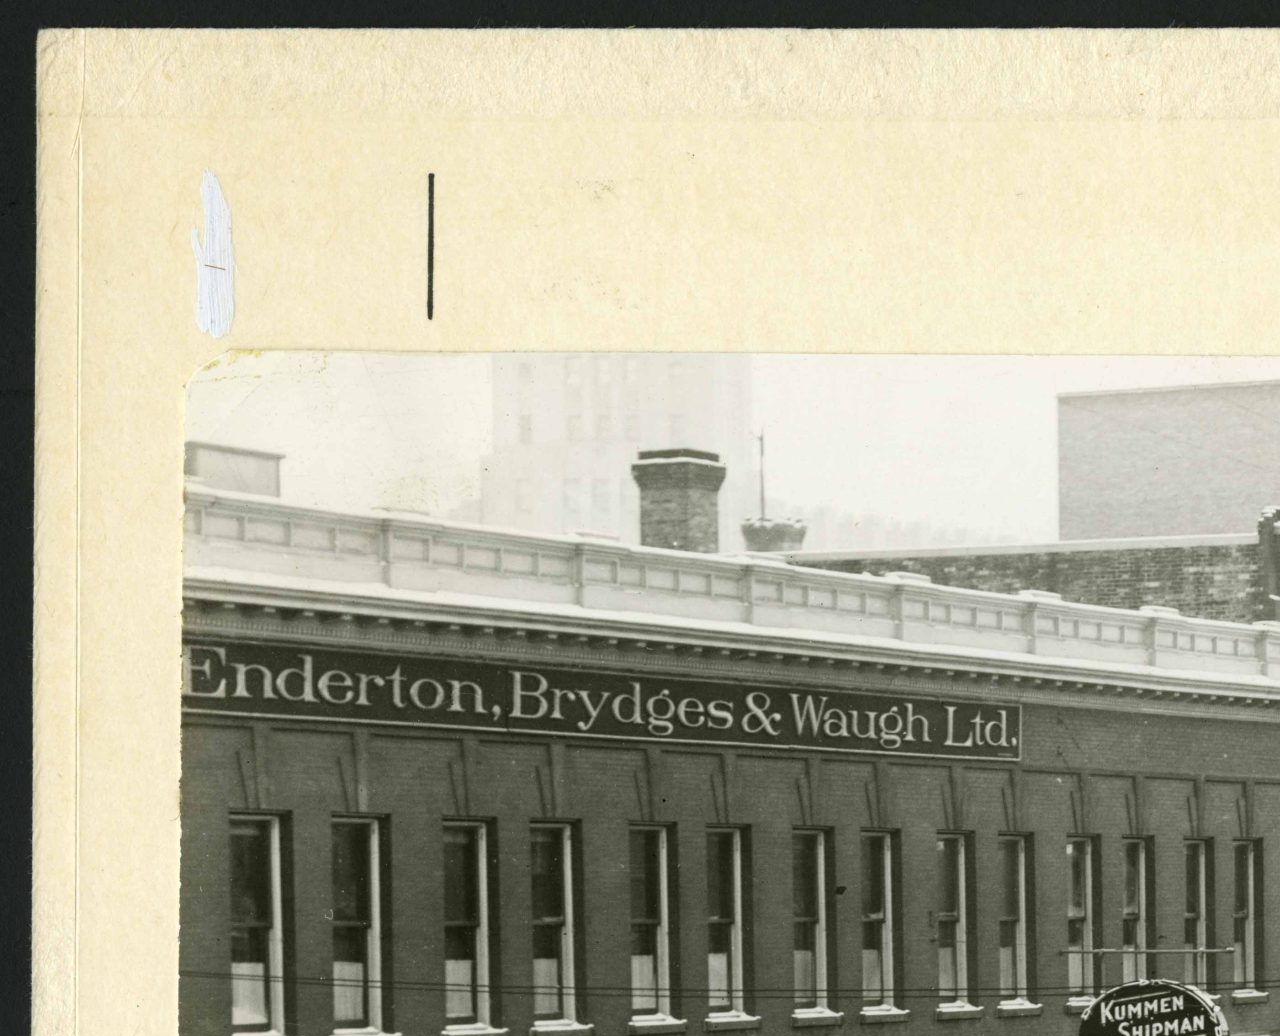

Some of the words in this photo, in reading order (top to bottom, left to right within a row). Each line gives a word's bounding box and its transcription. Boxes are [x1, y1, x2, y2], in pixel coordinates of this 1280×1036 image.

[184, 645, 500, 721] Enderton,
[509, 671, 734, 736] Brydges
[742, 692, 781, 735] &
[790, 694, 931, 748] Waugh
[944, 704, 1018, 748] Ltd.
[1100, 995, 1184, 1026] KUMMEN
